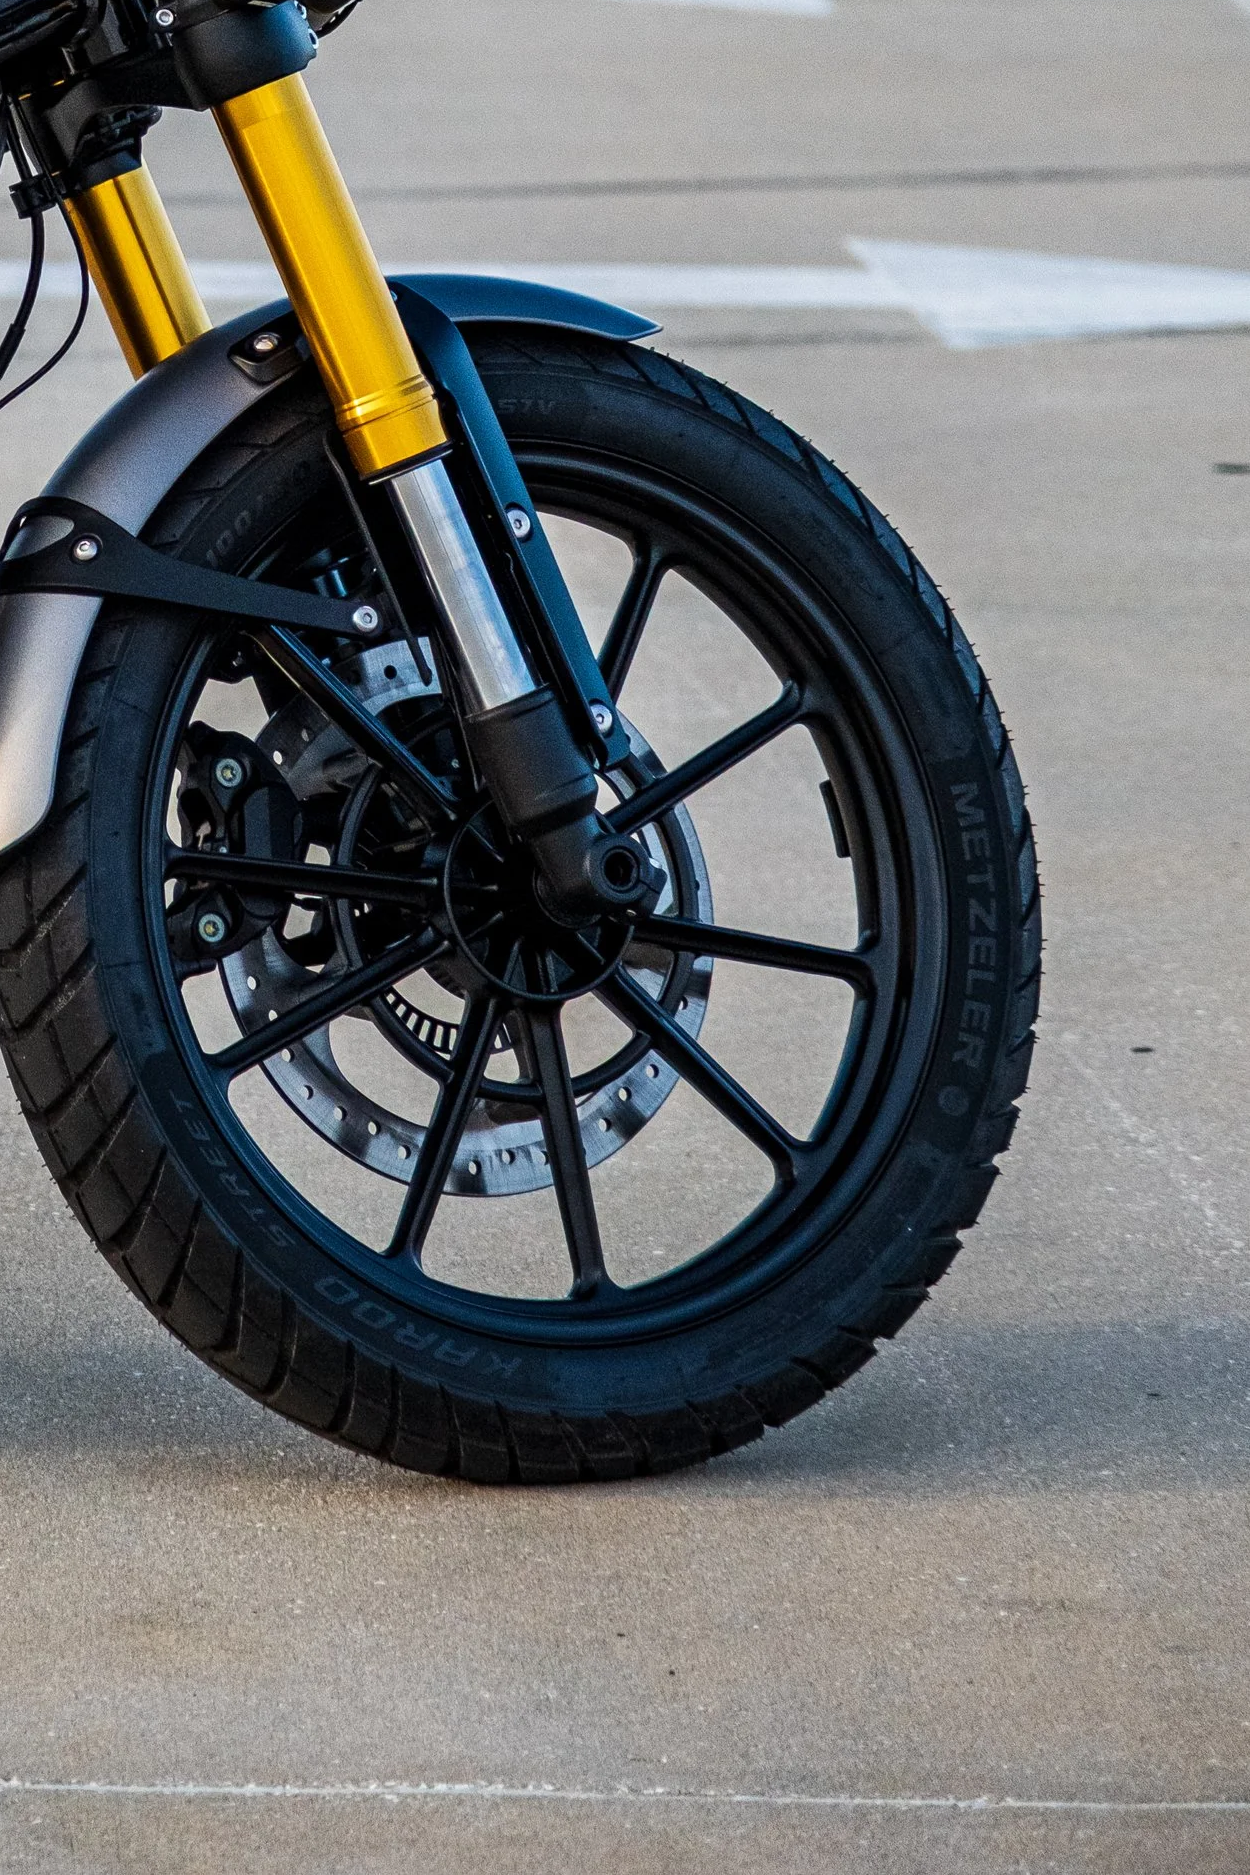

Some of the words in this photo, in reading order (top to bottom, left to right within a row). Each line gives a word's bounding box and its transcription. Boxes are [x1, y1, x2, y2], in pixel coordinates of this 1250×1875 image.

[950, 781, 997, 1069] METZELER
[169, 1088, 295, 1247] STREET
[314, 1275, 522, 1378] KAROO
